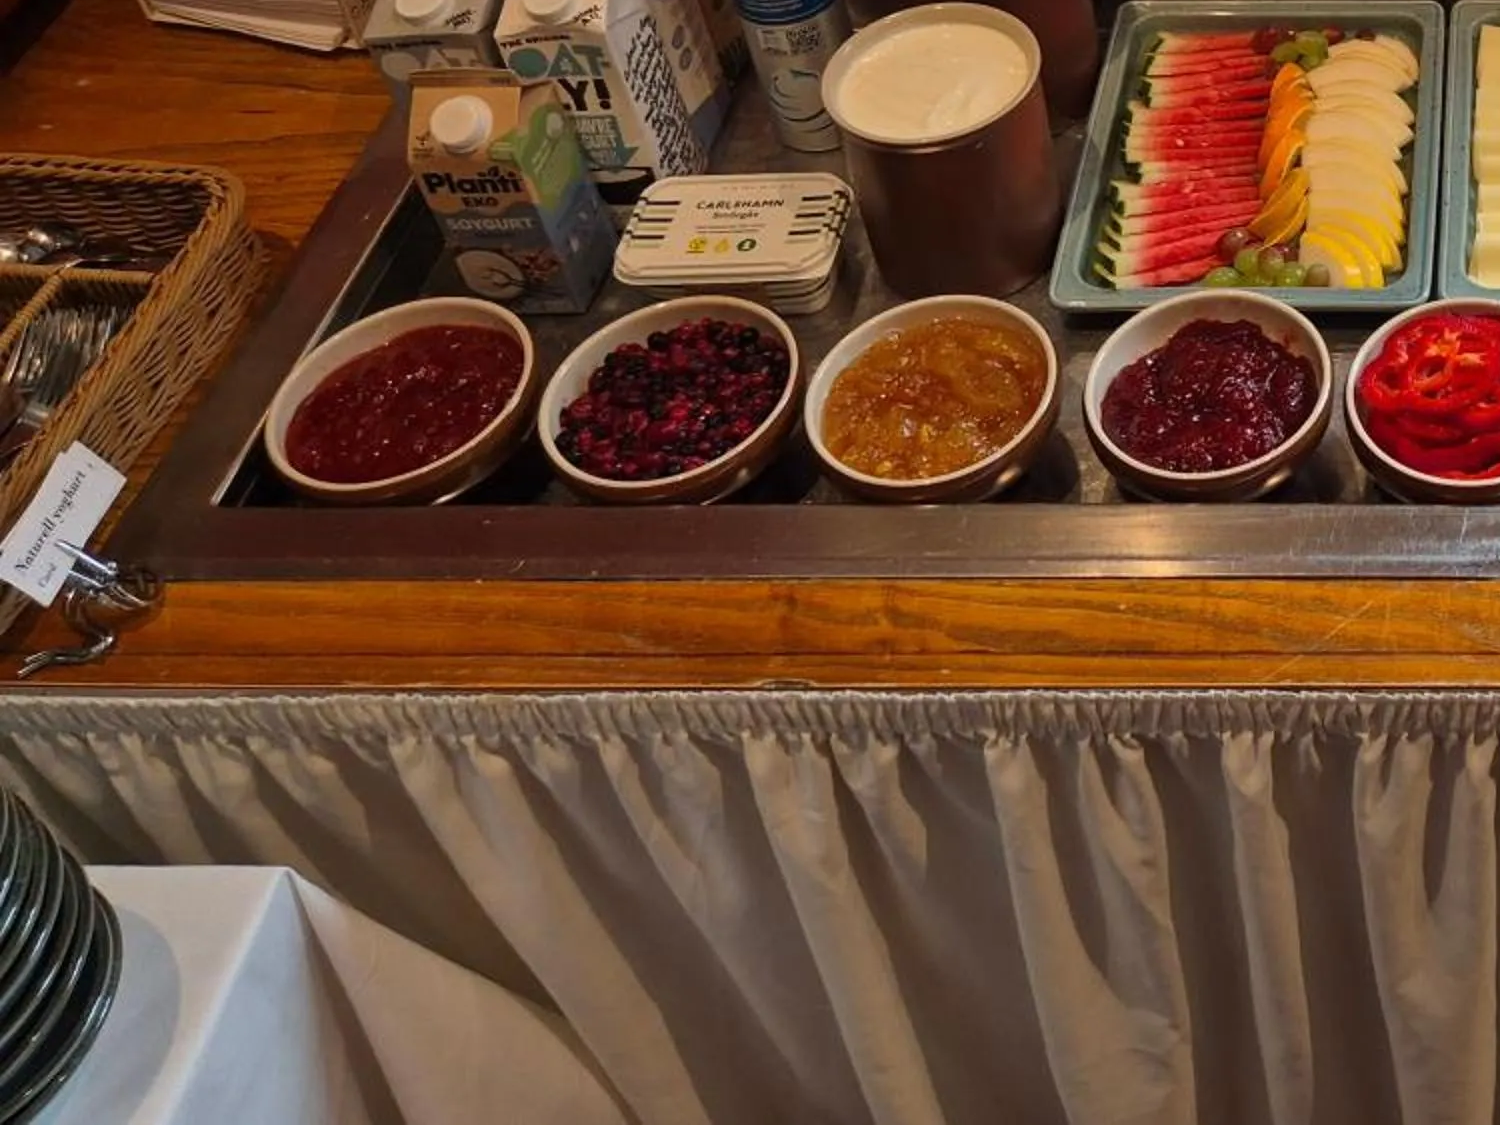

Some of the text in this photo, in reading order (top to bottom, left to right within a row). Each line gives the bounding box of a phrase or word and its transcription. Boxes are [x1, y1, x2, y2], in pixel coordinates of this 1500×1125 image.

[422, 167, 523, 195] Planti
[461, 196, 501, 207] EKO
[446, 216, 535, 230] SOYGURT
